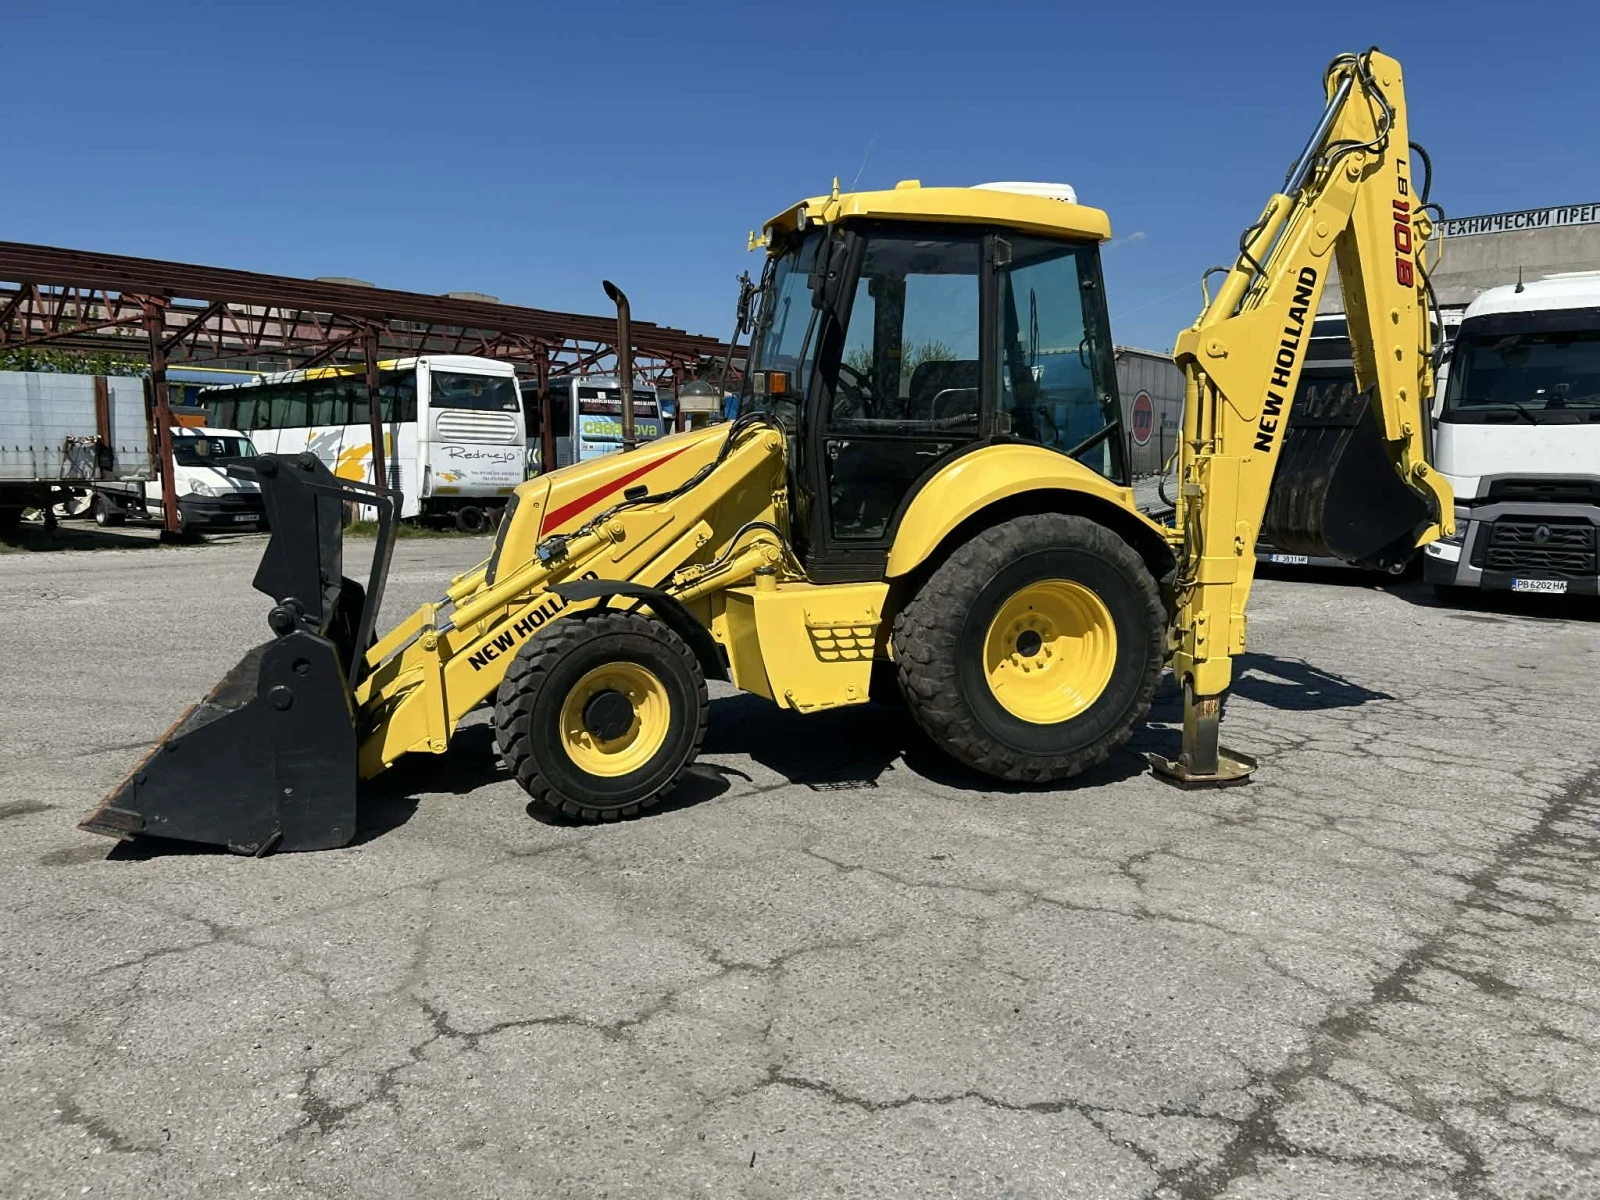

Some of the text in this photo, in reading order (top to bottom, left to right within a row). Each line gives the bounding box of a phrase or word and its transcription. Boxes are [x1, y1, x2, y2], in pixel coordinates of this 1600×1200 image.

[1442, 210, 1550, 236] ЕХНИЧЕСКИ
[1253, 266, 1318, 453] NEW HOLLAND
[583, 421, 657, 437] casaova
[441, 446, 516, 464] Redruejo
[1517, 580, 1565, 590] PB 6202 HA
[467, 630, 516, 672] NEW
